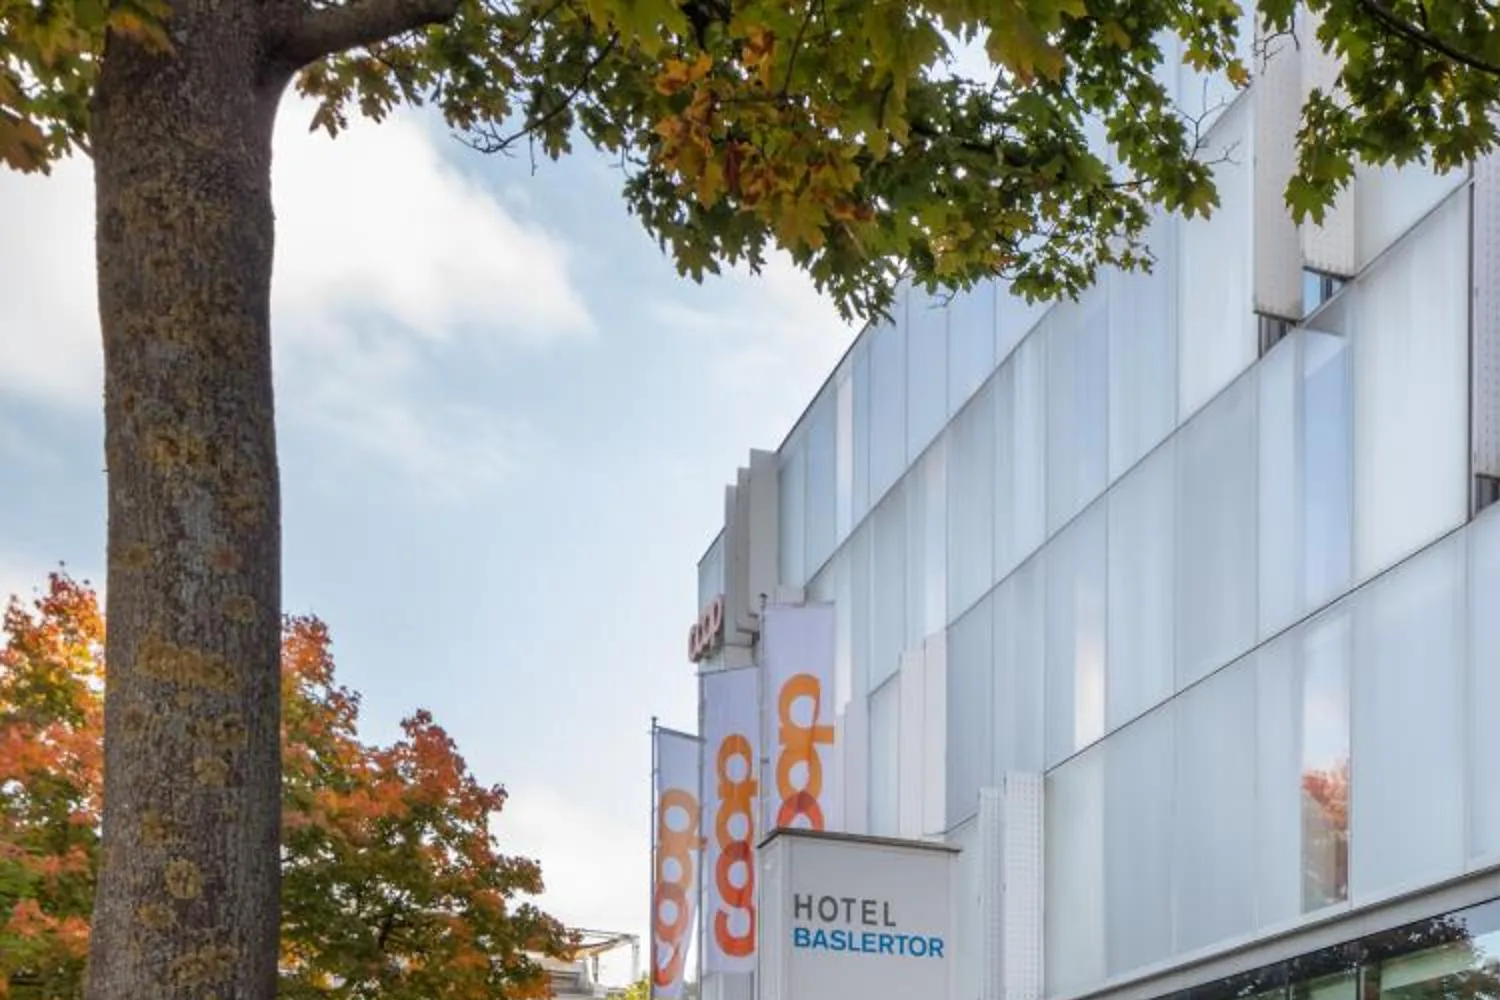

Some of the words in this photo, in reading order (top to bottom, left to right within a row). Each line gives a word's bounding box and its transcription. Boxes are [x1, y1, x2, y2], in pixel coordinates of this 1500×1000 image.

[777, 673, 834, 831] oop
[655, 788, 707, 987] coop
[715, 733, 758, 957] coop
[793, 894, 897, 927] HOTEL
[793, 927, 945, 958] BASLERTOR
